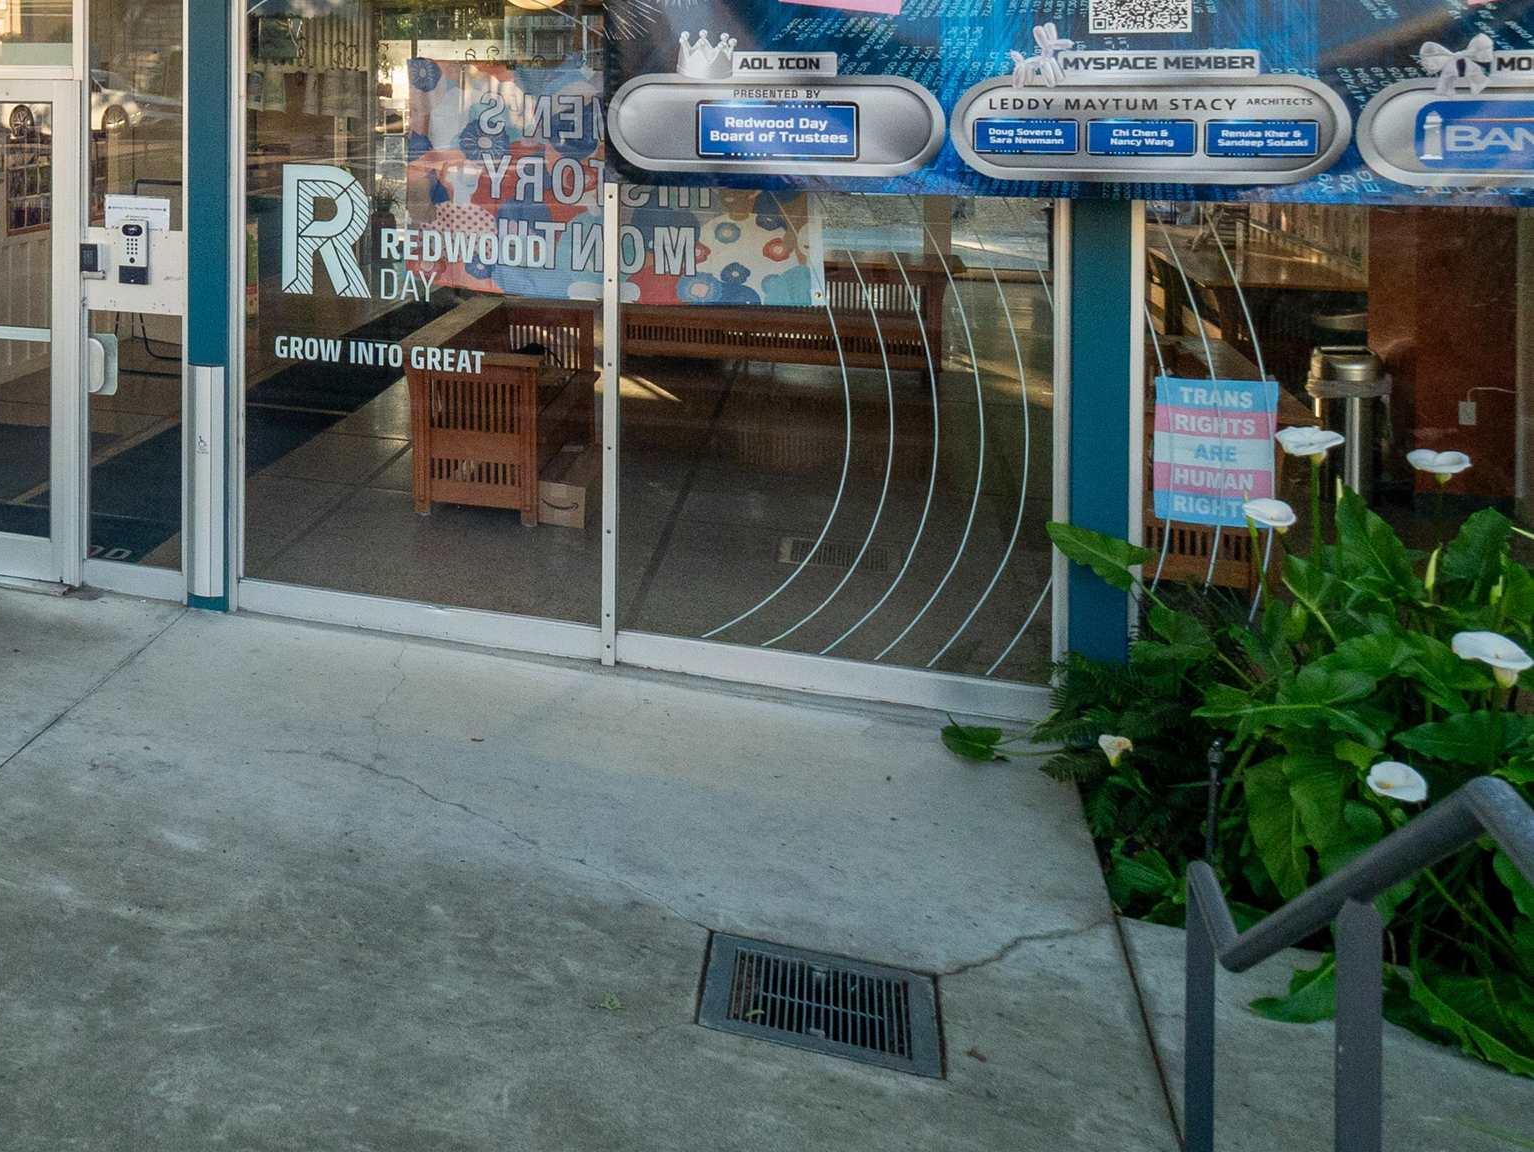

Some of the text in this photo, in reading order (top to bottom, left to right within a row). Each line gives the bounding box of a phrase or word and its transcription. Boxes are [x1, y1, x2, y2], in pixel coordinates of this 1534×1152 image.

[739, 57, 821, 70] AOL ICON
[1062, 56, 1256, 71] MYSPACE MEMBER
[733, 89, 821, 99] PRESENTED BY
[988, 98, 1313, 111] LEDDY MAYTUM STACY ARCHITECTS
[724, 116, 828, 132] Redwood Day
[710, 130, 849, 144] Board of Trustees
[988, 128, 1014, 137] Doug
[1054, 128, 1063, 136] &
[989, 136, 1013, 144] Sara
[1112, 128, 1169, 137] Chi Chen &
[1221, 129, 1262, 138] Renuka
[1292, 130, 1302, 138] &
[1110, 137, 1174, 147] Nancy Wang
[281, 163, 372, 299] R
[380, 227, 547, 269] REDWOOD
[380, 268, 438, 303] DAY
[274, 335, 486, 375] GROW INTO GREAT
[1179, 386, 1253, 409] TRANS
[1173, 413, 1256, 436] RIGHTS
[1194, 443, 1237, 463] ARE
[1173, 468, 1255, 491] HUMAN
[1172, 494, 1245, 519] RIGHT
